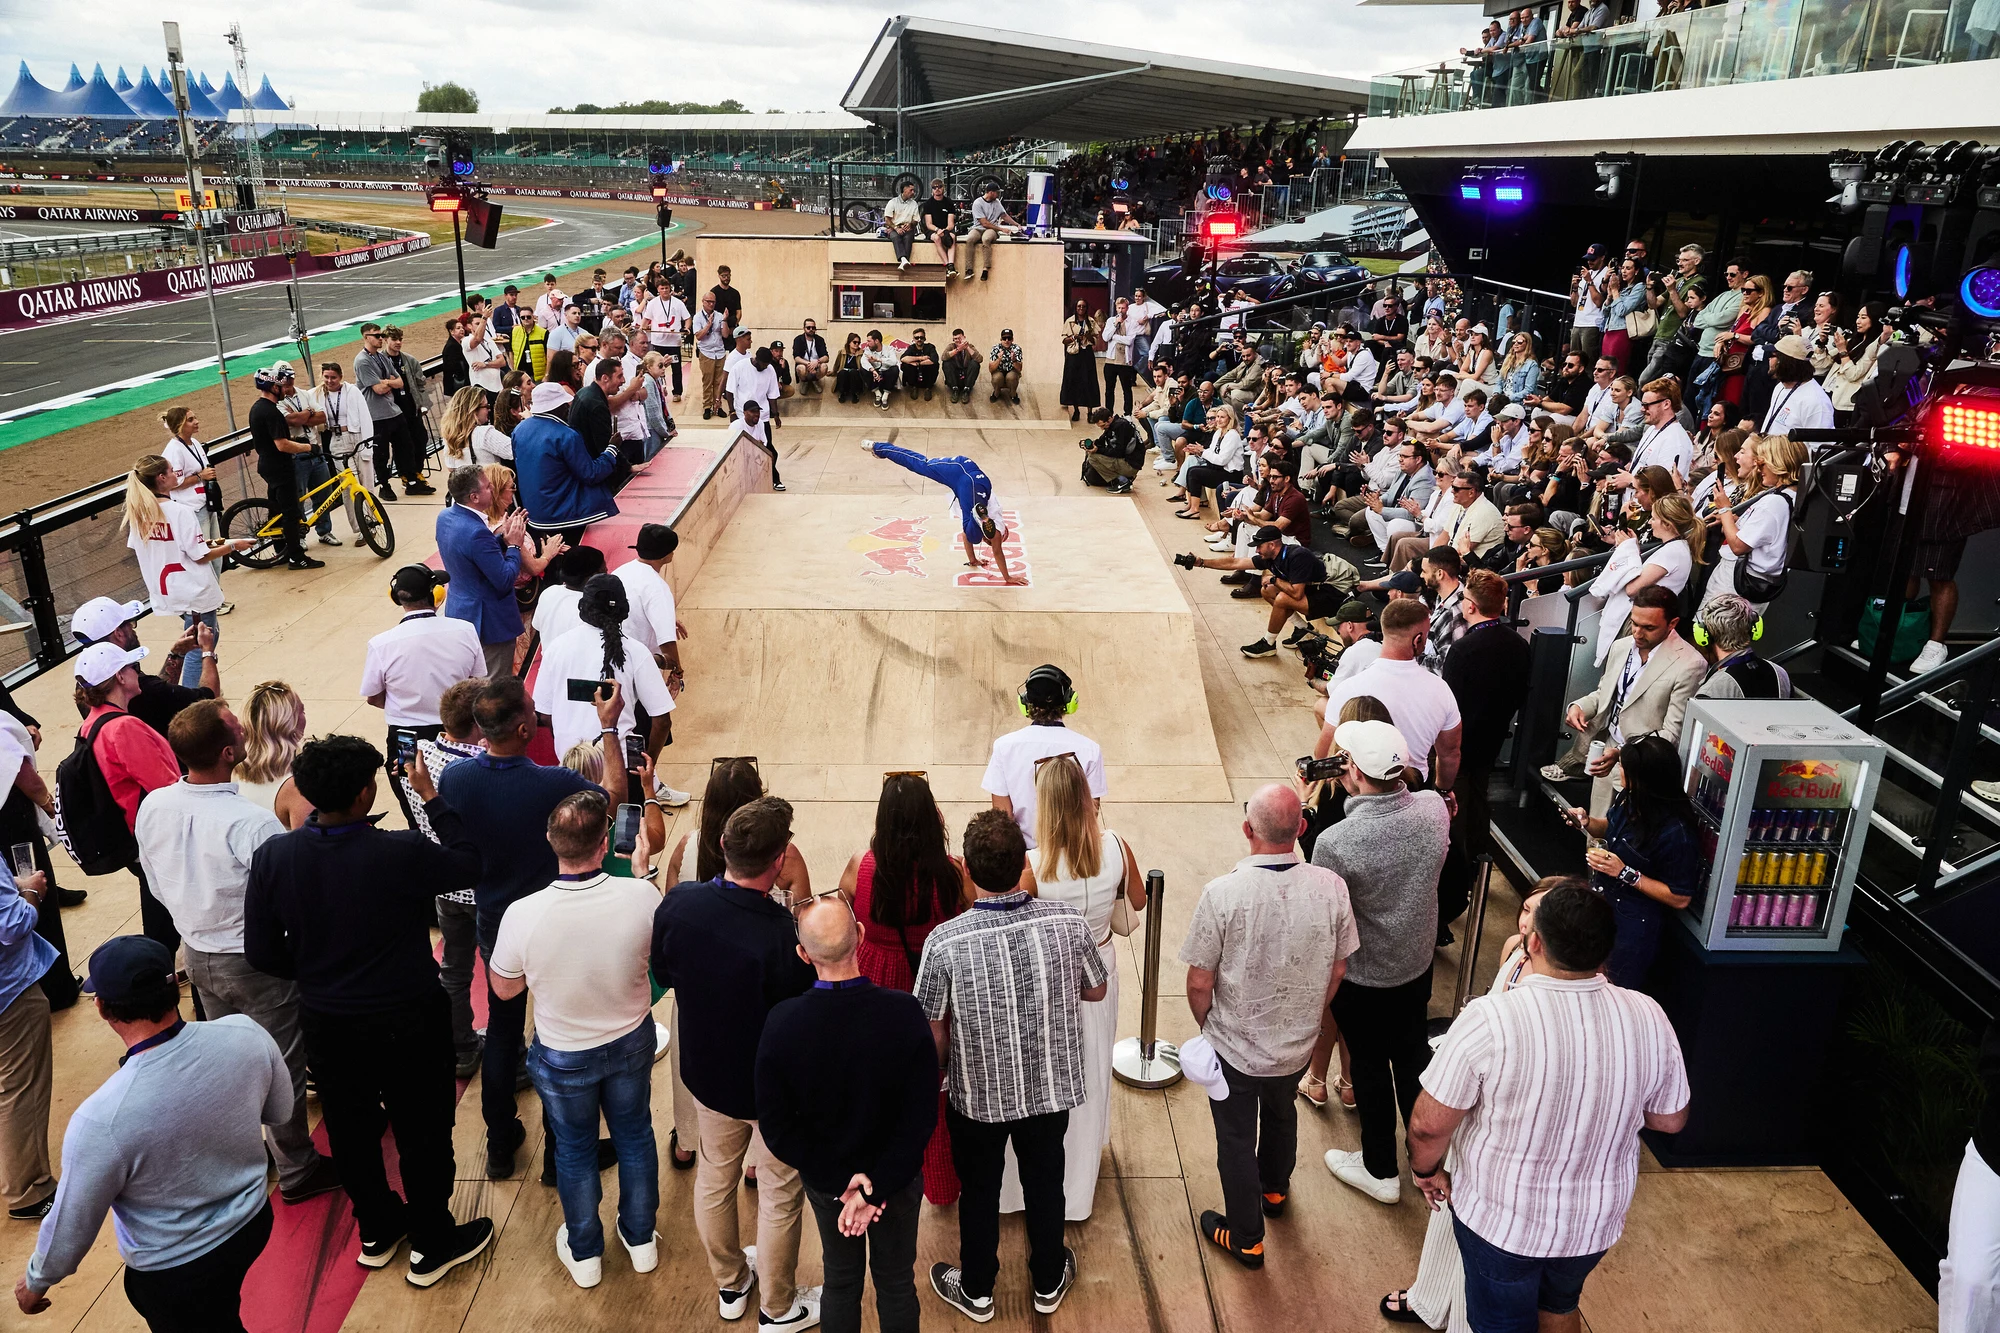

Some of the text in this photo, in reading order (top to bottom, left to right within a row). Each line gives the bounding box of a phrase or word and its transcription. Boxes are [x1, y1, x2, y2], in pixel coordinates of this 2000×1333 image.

[143, 176, 168, 184] QATAR
[275, 180, 300, 188] QATAR
[401, 184, 425, 192] QATAR
[569, 190, 589, 199] QATAR
[634, 194, 653, 202] AIRWAYS
[663, 196, 699, 206] ATAR AIRWAYS
[707, 200, 749, 209] QATAR AIRWAYS
[38, 208, 139, 222] QATAR AIRWAYS
[236, 214, 262, 232] QATAR
[373, 242, 405, 261] QATAR AIRWAYS
[334, 250, 370, 269] QATAR AIRWAYS
[167, 260, 256, 294] QATAR AIRWAYS
[18, 276, 142, 319] QATAR AIRWAYS
[316, 499, 333, 517] SANTA
[331, 486, 344, 501] CRUZ
[148, 524, 169, 539] REW
[1699, 745, 1718, 772] Red
[1767, 781, 1842, 799] Red Bull
